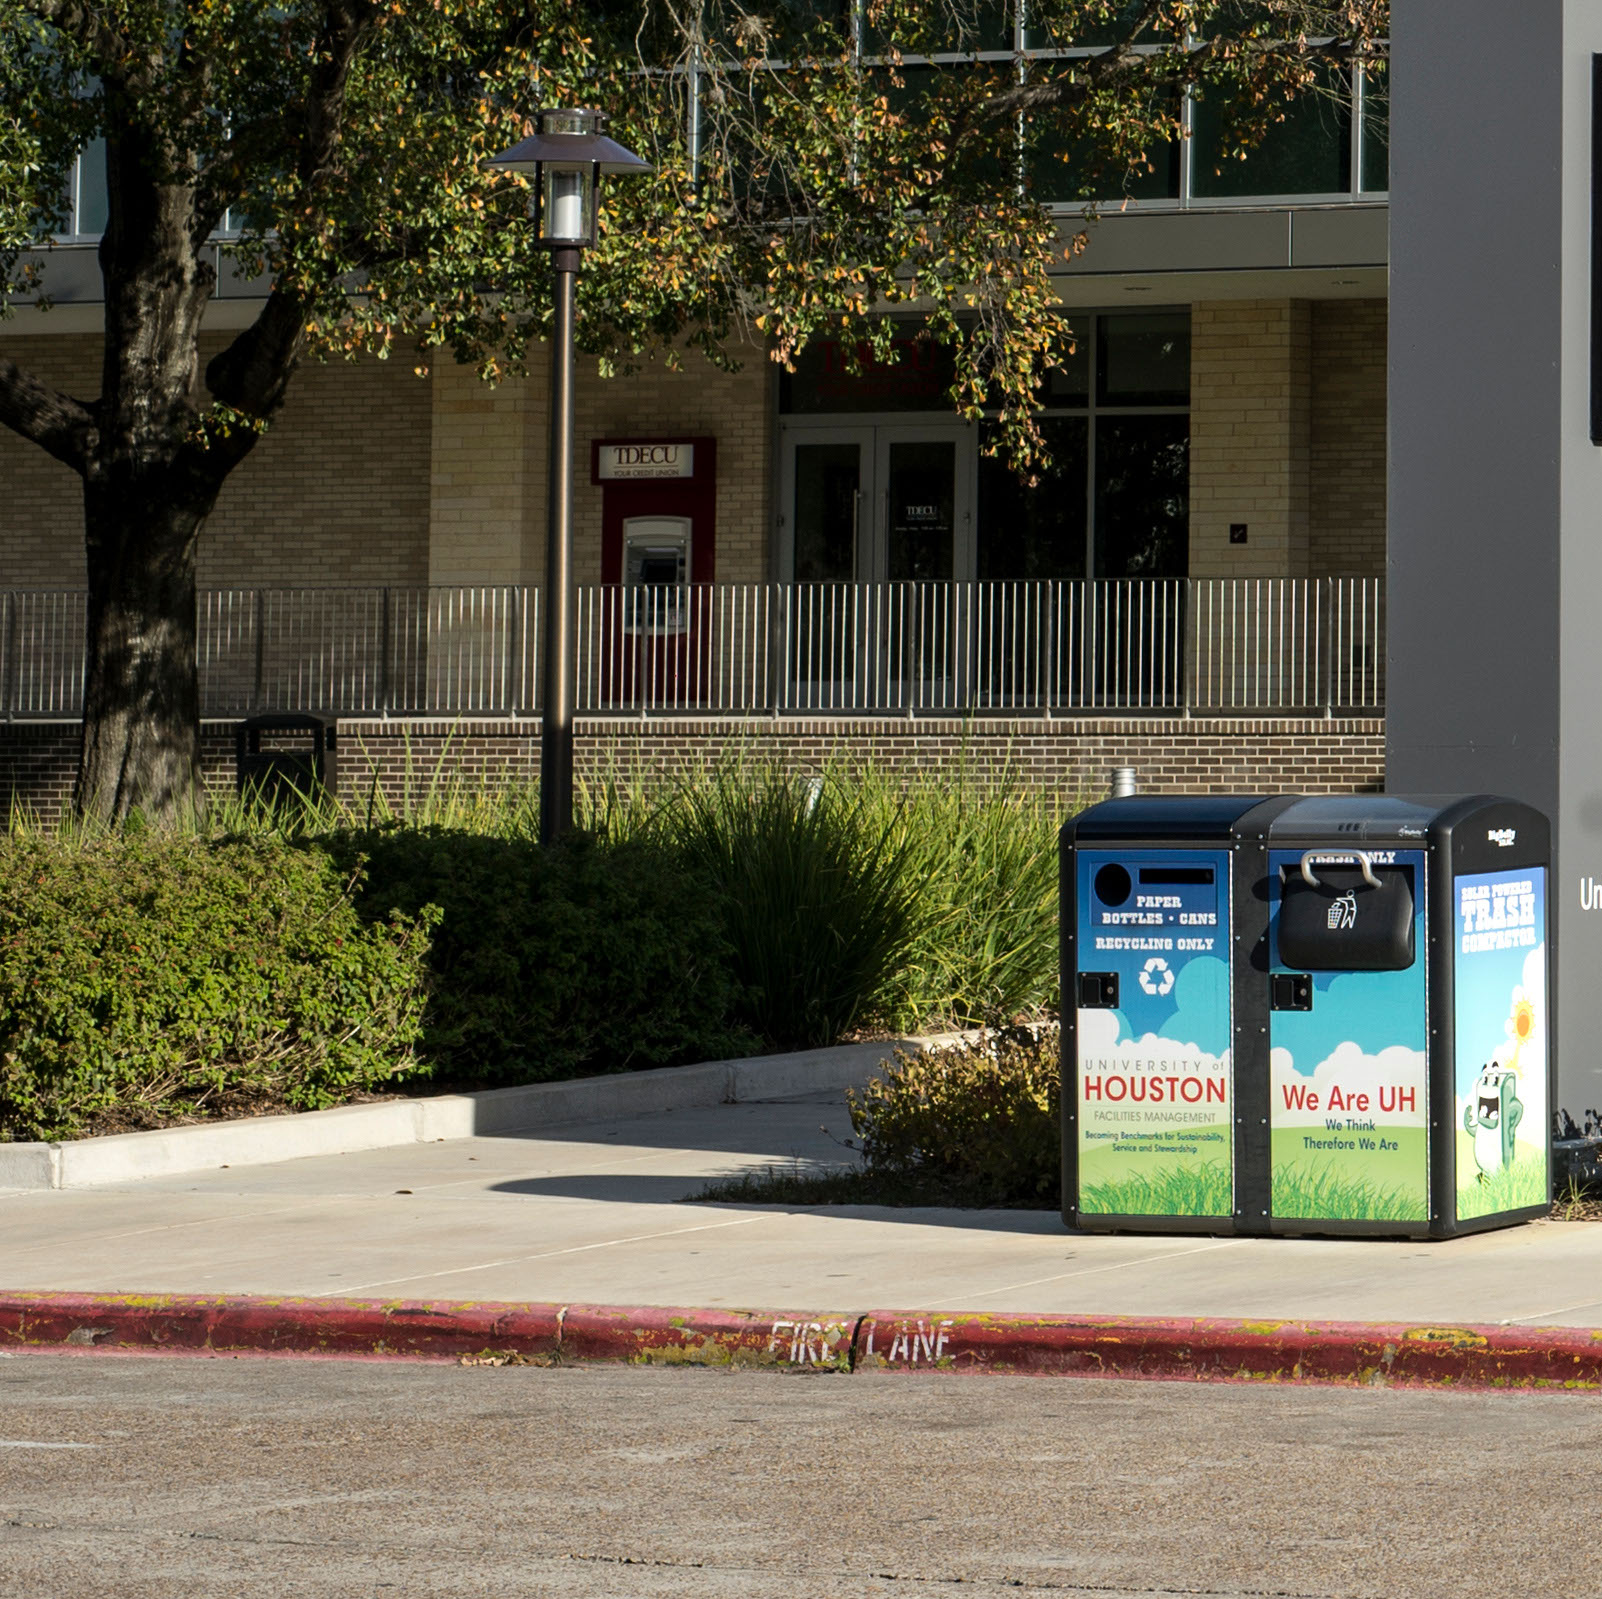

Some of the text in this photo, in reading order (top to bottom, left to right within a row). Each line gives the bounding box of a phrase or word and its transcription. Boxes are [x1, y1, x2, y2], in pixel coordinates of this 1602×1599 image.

[613, 446, 679, 465] TDECU
[632, 469, 655, 477] CREDIT
[655, 468, 680, 476] UNION
[1367, 851, 1396, 864] NLY
[1461, 885, 1490, 901] SOLAR
[1136, 895, 1182, 908] PAPER
[1102, 912, 1217, 925] BOTTLES CANS
[1461, 893, 1535, 933] TRASH
[1095, 937, 1214, 950] RECYCLING ONLY
[1462, 927, 1536, 954] COMPACTOR
[1085, 1059, 1224, 1072] UNIVERSITY of
[1084, 1075, 1226, 1103] HOUSTON
[1282, 1084, 1415, 1112] We Are UH
[1094, 1110, 1216, 1123] FACILITIES MANAGEMENT
[1325, 1118, 1376, 1132] We Think
[1085, 1130, 1119, 1142] Becoming
[1121, 1131, 1163, 1141] Benchmarks
[1165, 1131, 1175, 1141] for
[1112, 1143, 1198, 1155] Service and Stewardship
[1303, 1136, 1399, 1151] Therefore We Are
